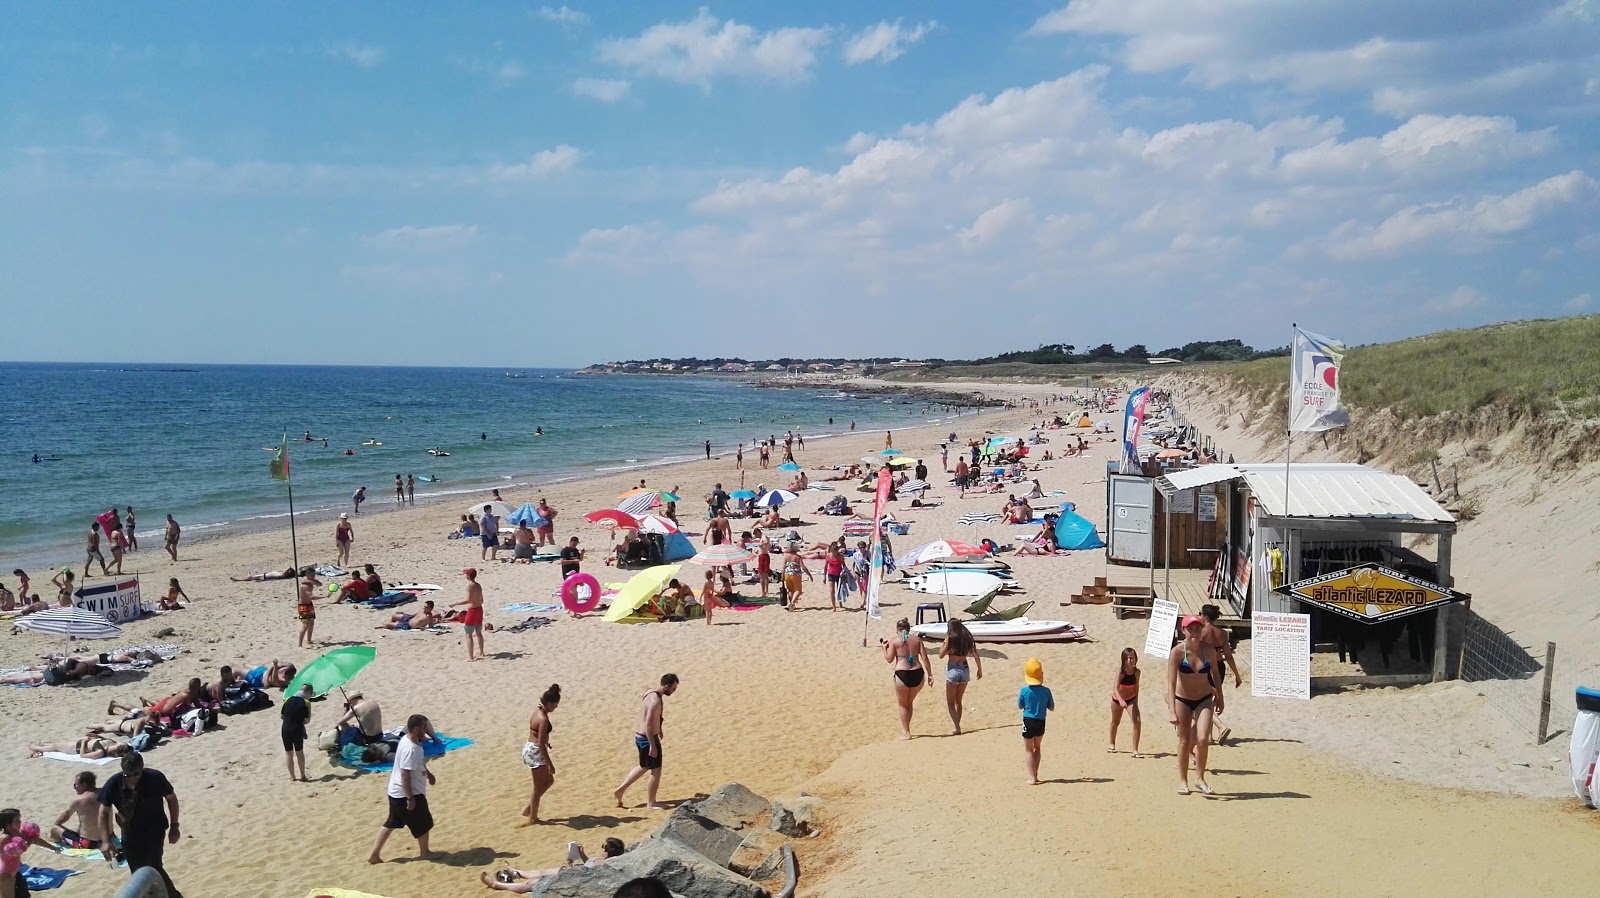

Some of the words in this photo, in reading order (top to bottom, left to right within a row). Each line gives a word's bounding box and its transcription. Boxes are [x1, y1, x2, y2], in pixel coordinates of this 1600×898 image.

[1304, 380, 1322, 390] ÉCOLE
[1304, 396, 1324, 406] SURF
[1290, 570, 1348, 589] LOCATION
[1378, 566, 1406, 579] SURF
[1408, 576, 1453, 595] SCHOOL
[76, 596, 118, 612] SWIM
[120, 590, 138, 608] SURF
[1313, 586, 1365, 604] atlantic
[1366, 588, 1426, 606] LEZARD
[1279, 616, 1307, 624] LEZARD
